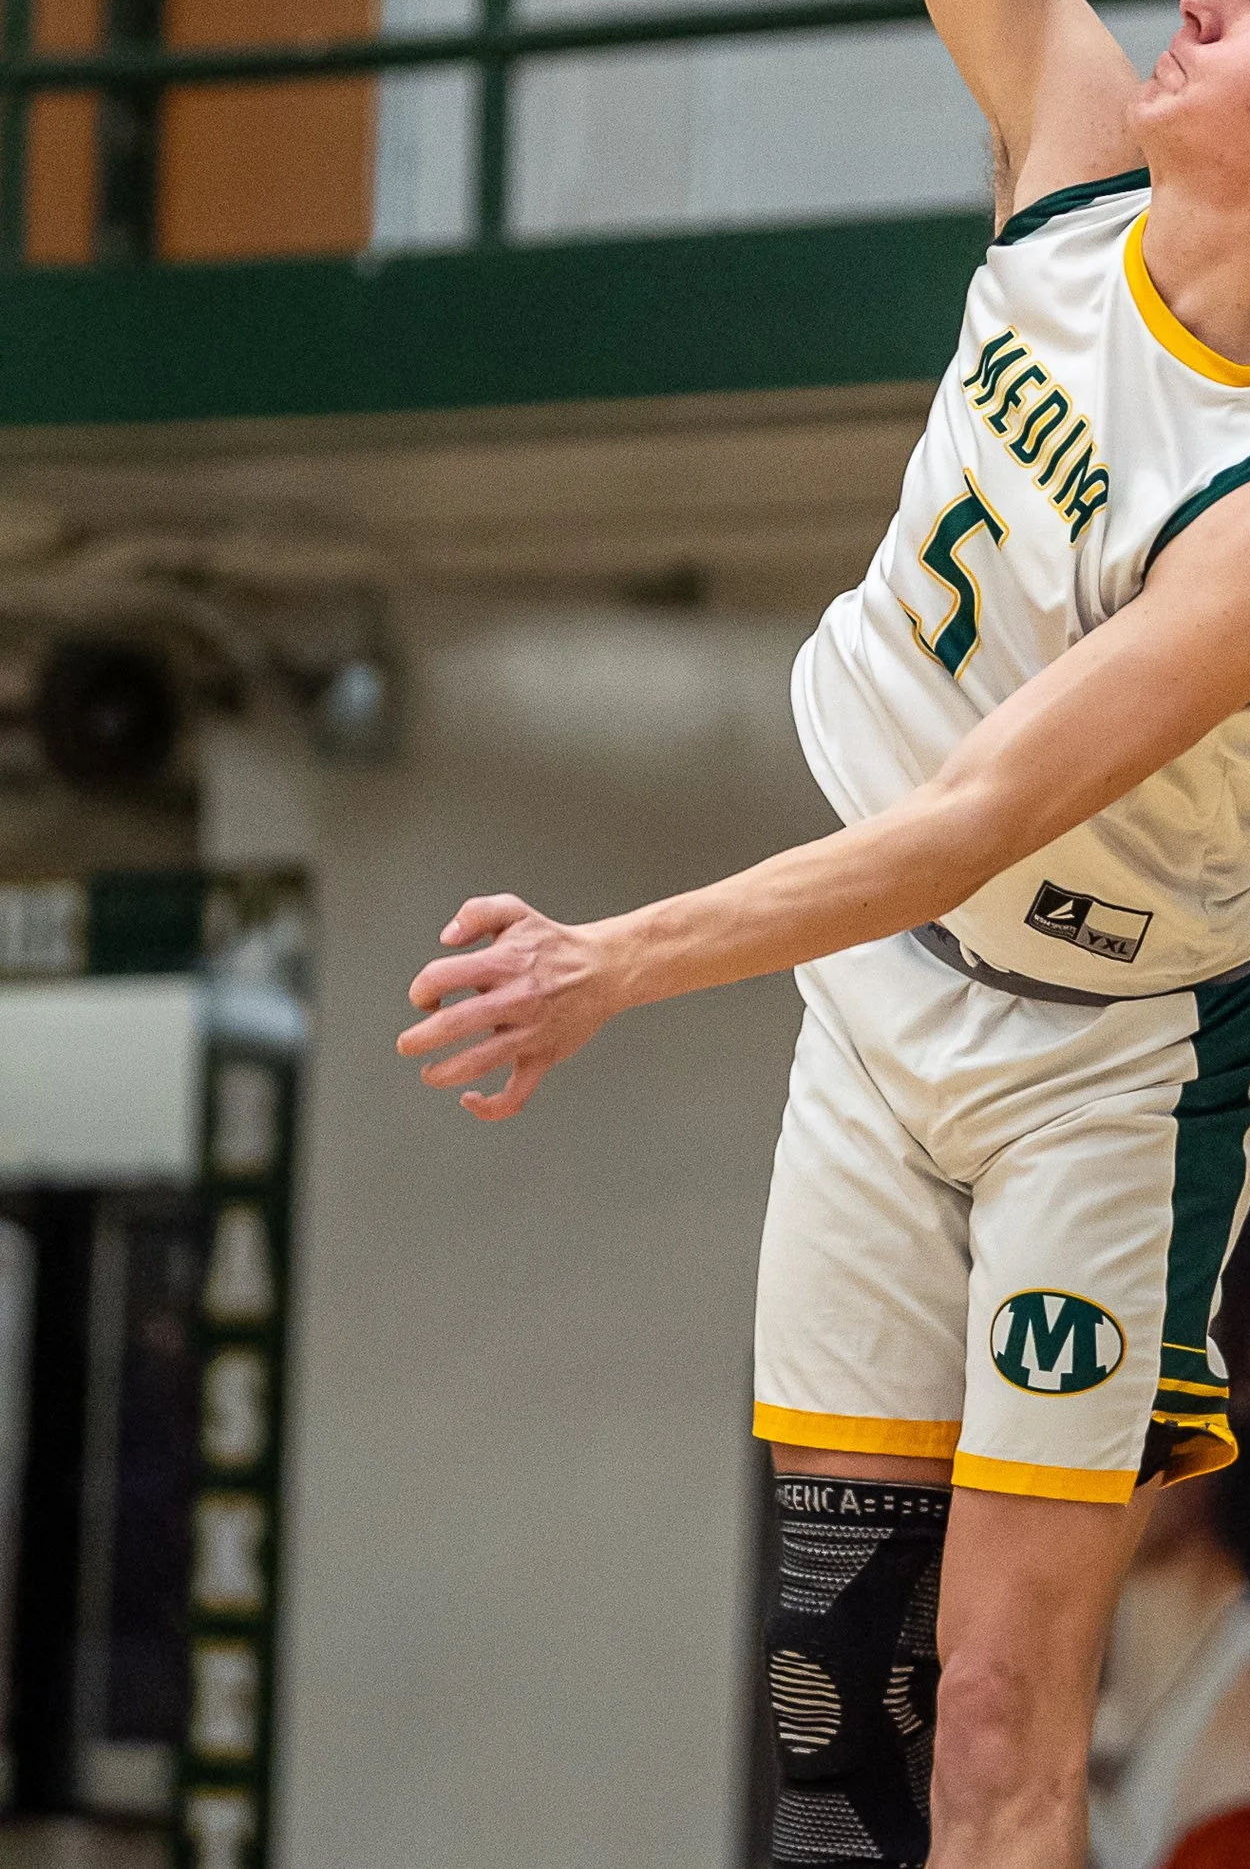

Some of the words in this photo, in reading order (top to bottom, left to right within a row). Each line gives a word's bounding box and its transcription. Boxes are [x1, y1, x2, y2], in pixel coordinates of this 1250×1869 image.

[960, 324, 1112, 546] MEDINA
[897, 467, 1009, 682] 5
[1087, 930, 1128, 955] YXL
[996, 1292, 1105, 1393] M
